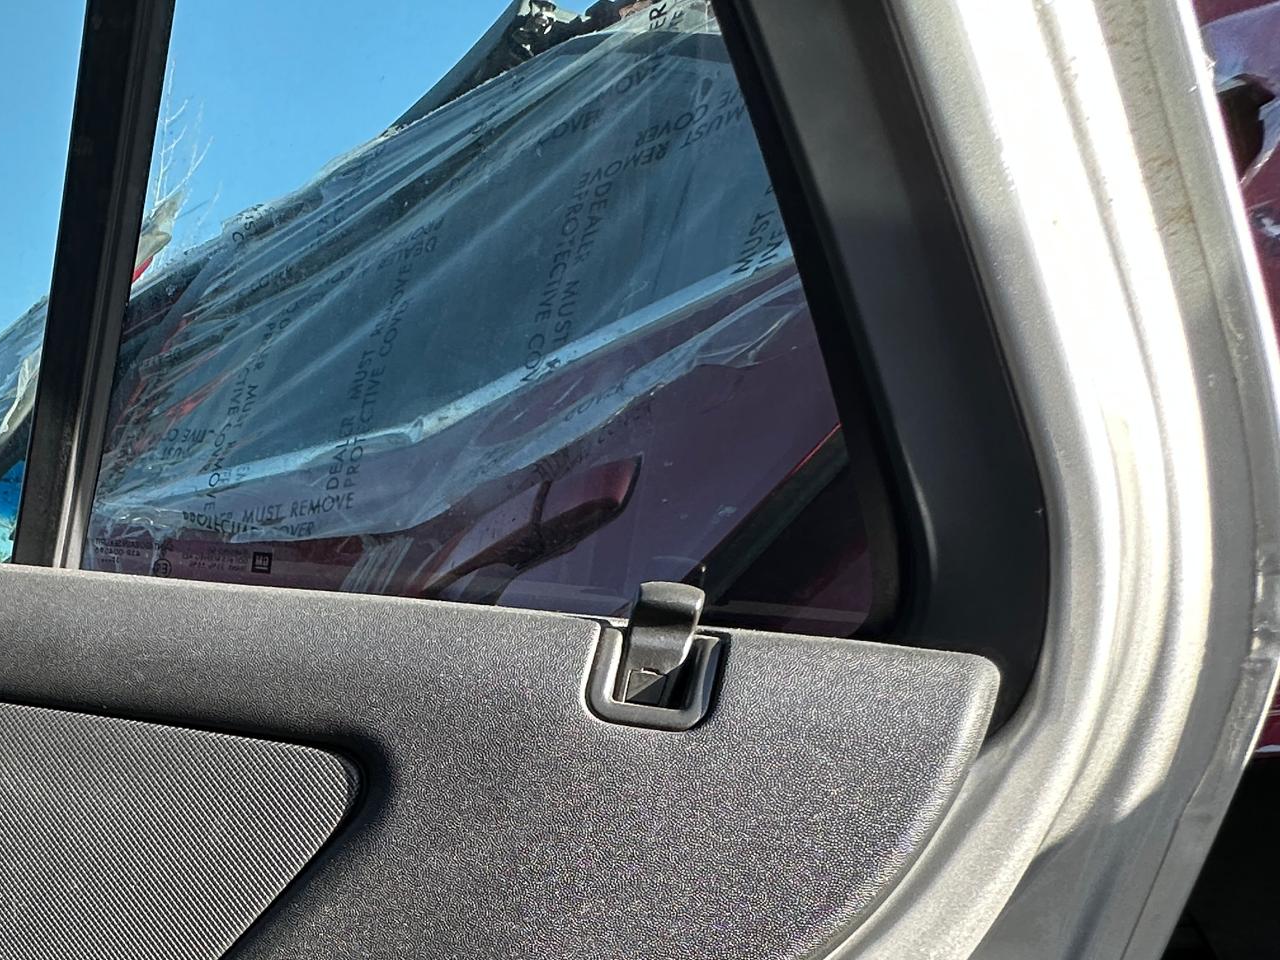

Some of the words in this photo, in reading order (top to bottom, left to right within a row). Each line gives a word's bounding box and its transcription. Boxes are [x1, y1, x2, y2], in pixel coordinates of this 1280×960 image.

[577, 141, 670, 187] REMOVE
[730, 209, 775, 275] MUST
[552, 280, 580, 344] MUST
[326, 416, 355, 490] DEALER
[350, 349, 376, 401] MUST
[289, 492, 355, 519] REMOVE
